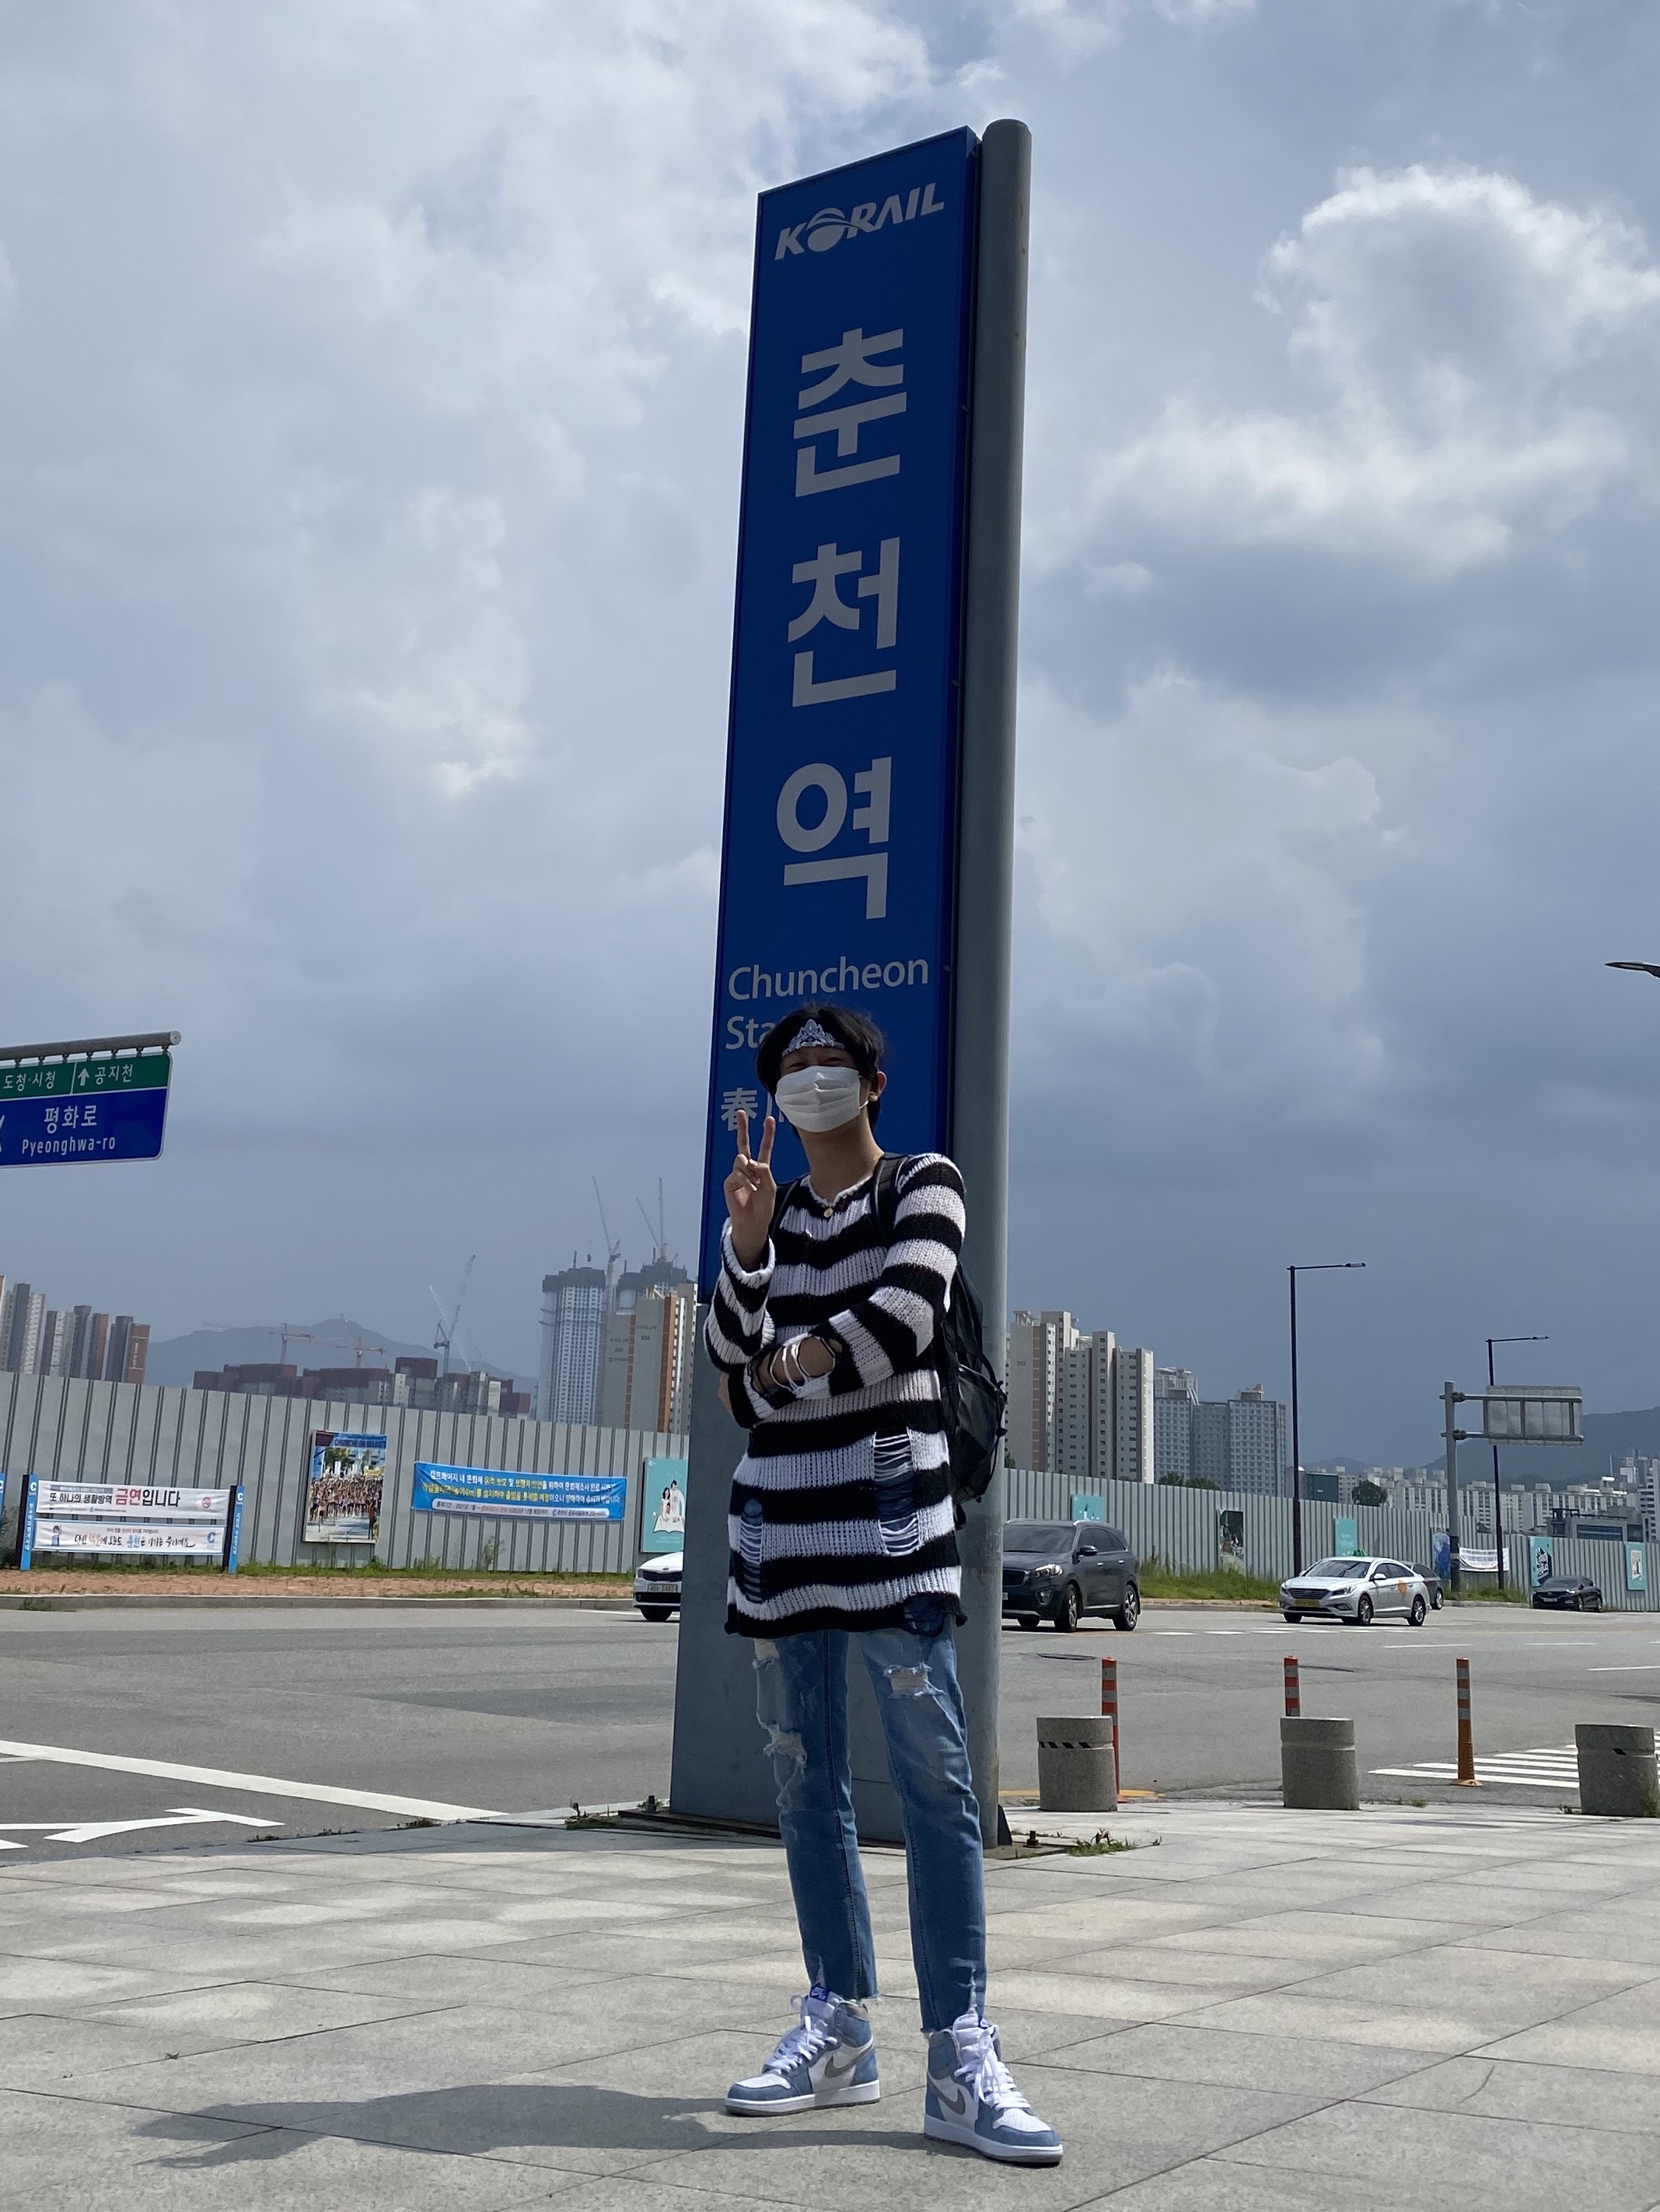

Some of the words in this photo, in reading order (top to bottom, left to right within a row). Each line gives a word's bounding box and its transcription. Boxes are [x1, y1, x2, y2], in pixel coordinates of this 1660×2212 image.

[774, 183, 945, 260] KORAIL
[778, 327, 907, 921] 춘천역
[729, 956, 929, 1001] Chuncheon
[94, 1064, 134, 1085] 공지천
[44, 1105, 97, 1134] 평화로
[22, 1137, 116, 1157] Pyeonghwa-ro
[50, 1492, 57, 1501] 또
[59, 1493, 81, 1503] 하나의
[83, 1494, 113, 1504] 생활방역
[116, 1488, 180, 1507] 금연입니다
